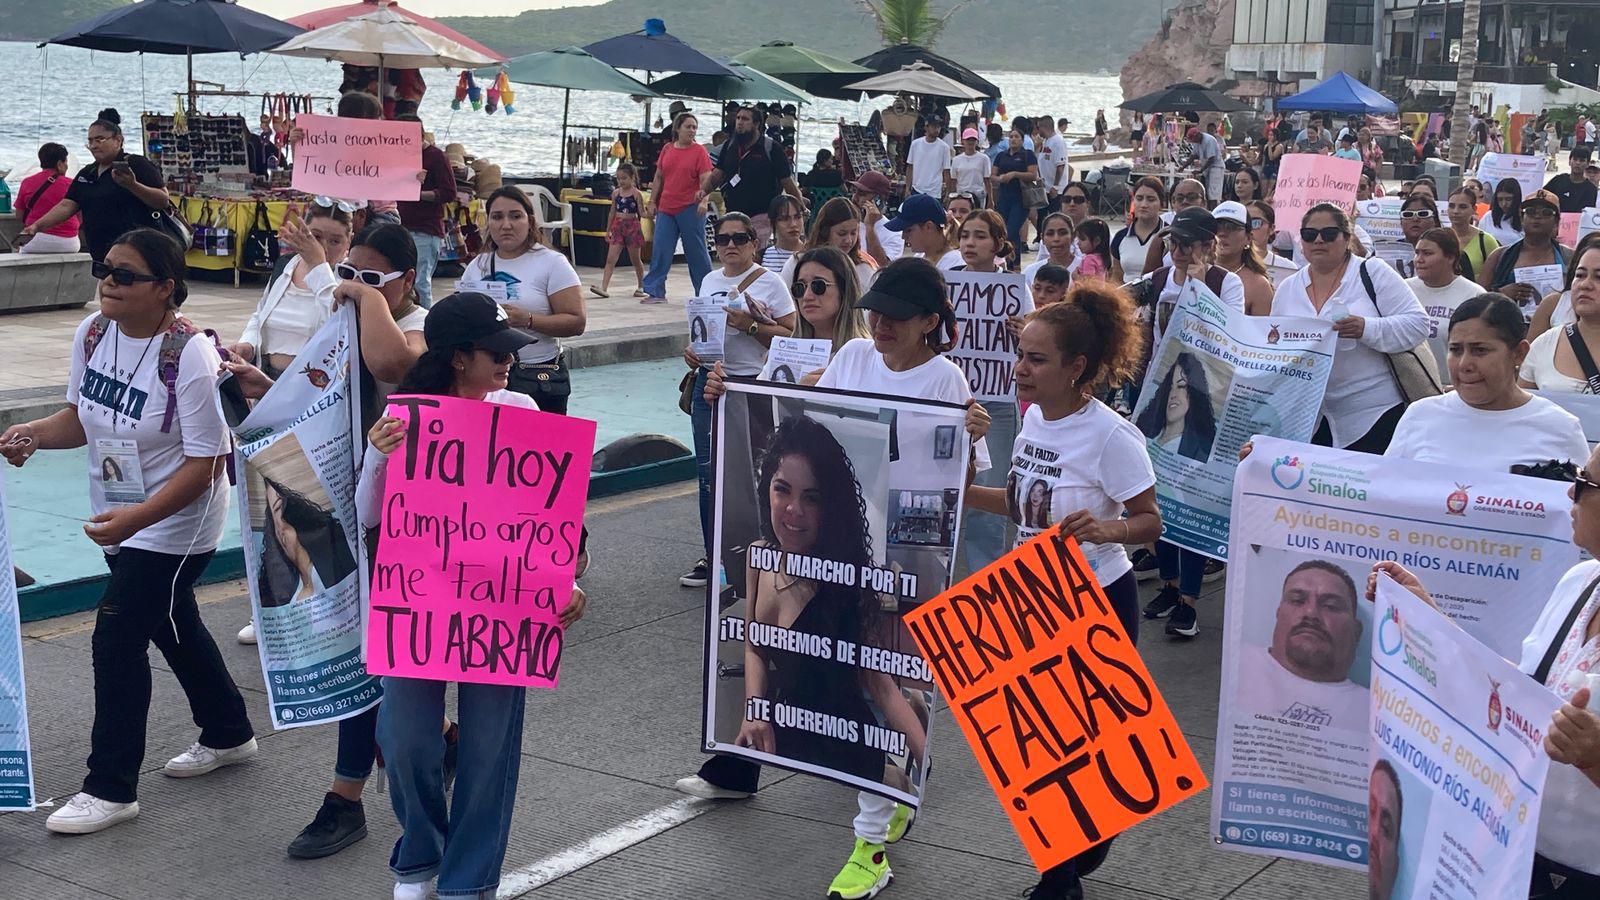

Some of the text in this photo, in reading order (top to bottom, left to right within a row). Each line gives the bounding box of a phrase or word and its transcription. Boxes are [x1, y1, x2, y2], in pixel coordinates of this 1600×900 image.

[344, 133, 412, 146] encontrarte
[1278, 177, 1292, 188] as
[1323, 174, 1357, 193] llevaron
[1306, 198, 1352, 212] qumos
[946, 282, 1021, 316] TAMOS
[1197, 301, 1226, 327] Sinaloa
[1425, 305, 1455, 320] NGELE
[956, 317, 1018, 355] ALTAN
[1183, 319, 1315, 367] yúdanos a encontrar a
[1283, 331, 1322, 339] SINALOA
[1179, 330, 1193, 344] RÍA
[1222, 351, 1278, 373] BERRELLEZA
[1280, 367, 1313, 381] FLORES
[945, 355, 1017, 396] RISTINA
[80, 401, 95, 411] EW
[487, 407, 573, 509] hoy
[1308, 478, 1367, 501] Sinaloa
[1475, 496, 1546, 512] SINALOA
[1167, 511, 1176, 519] Tu
[1176, 516, 1199, 528] ayuda
[1200, 523, 1210, 531] es
[1180, 507, 1213, 523] referente
[1473, 506, 1505, 514] GOBIERNO
[387, 492, 487, 572] Cumplo
[497, 513, 575, 572] años
[1273, 505, 1542, 561] Ayúdanos a encontrar a
[750, 547, 917, 597] HOY MARCHO POR TI
[1287, 534, 1519, 581] LUIS ANTONIO RÍOS ALEMÁN
[377, 562, 427, 602] me
[909, 535, 1109, 700] HERMANA
[372, 605, 433, 670] TU
[445, 612, 563, 682] ABRAZO
[720, 616, 935, 683] ¡TE QUEREMOS DE REGRESO
[275, 674, 282, 684] Si
[289, 672, 319, 684] tienes
[1403, 644, 1437, 688] Sinaloa
[277, 686, 306, 696] llama
[308, 686, 377, 717] (669) 327 8424
[961, 623, 1153, 789] FALTAS
[747, 697, 906, 756] ¡TE QUEREMOS VIVA!
[1506, 706, 1543, 746] SINALO
[0, 757, 25, 765] rsona,
[1372, 675, 1440, 744] Ayúdanos
[1442, 735, 1453, 755] a
[1518, 803, 1527, 824] a
[0, 768, 26, 777] rtante.
[1375, 716, 1510, 848] LUIS ANTONIO RÍOS ALEMÁN
[1228, 801, 1261, 814] llama
[1266, 807, 1274, 815] o
[1355, 821, 1368, 833] Tu
[1230, 787, 1367, 819] Si tienes información
[1260, 830, 1342, 852] (669) 327 8424
